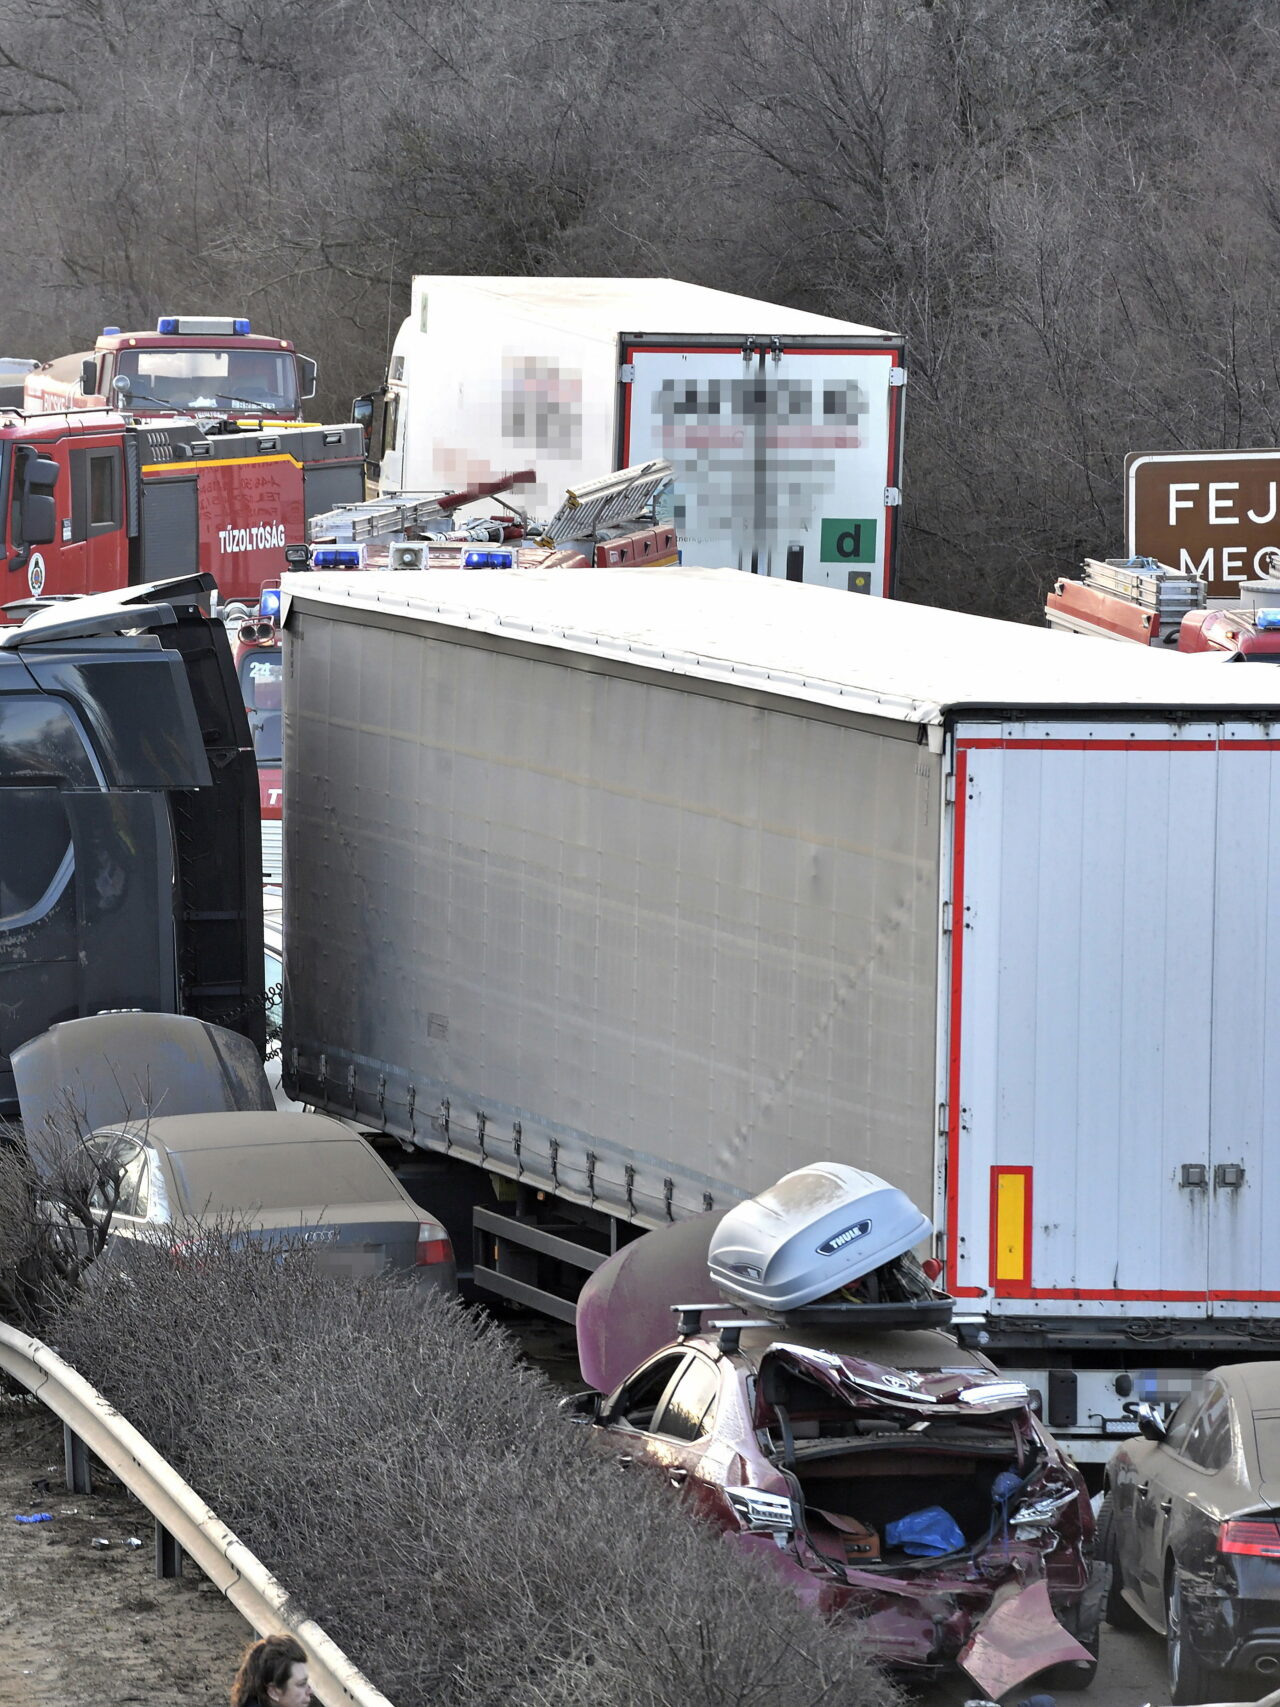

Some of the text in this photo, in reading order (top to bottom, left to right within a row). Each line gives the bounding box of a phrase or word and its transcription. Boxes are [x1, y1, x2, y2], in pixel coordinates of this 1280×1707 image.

[1168, 481, 1277, 526] FEJ
[218, 520, 285, 554] TŰZOLTÓSÁG
[836, 523, 861, 558] d
[828, 1226, 862, 1249] THULE
